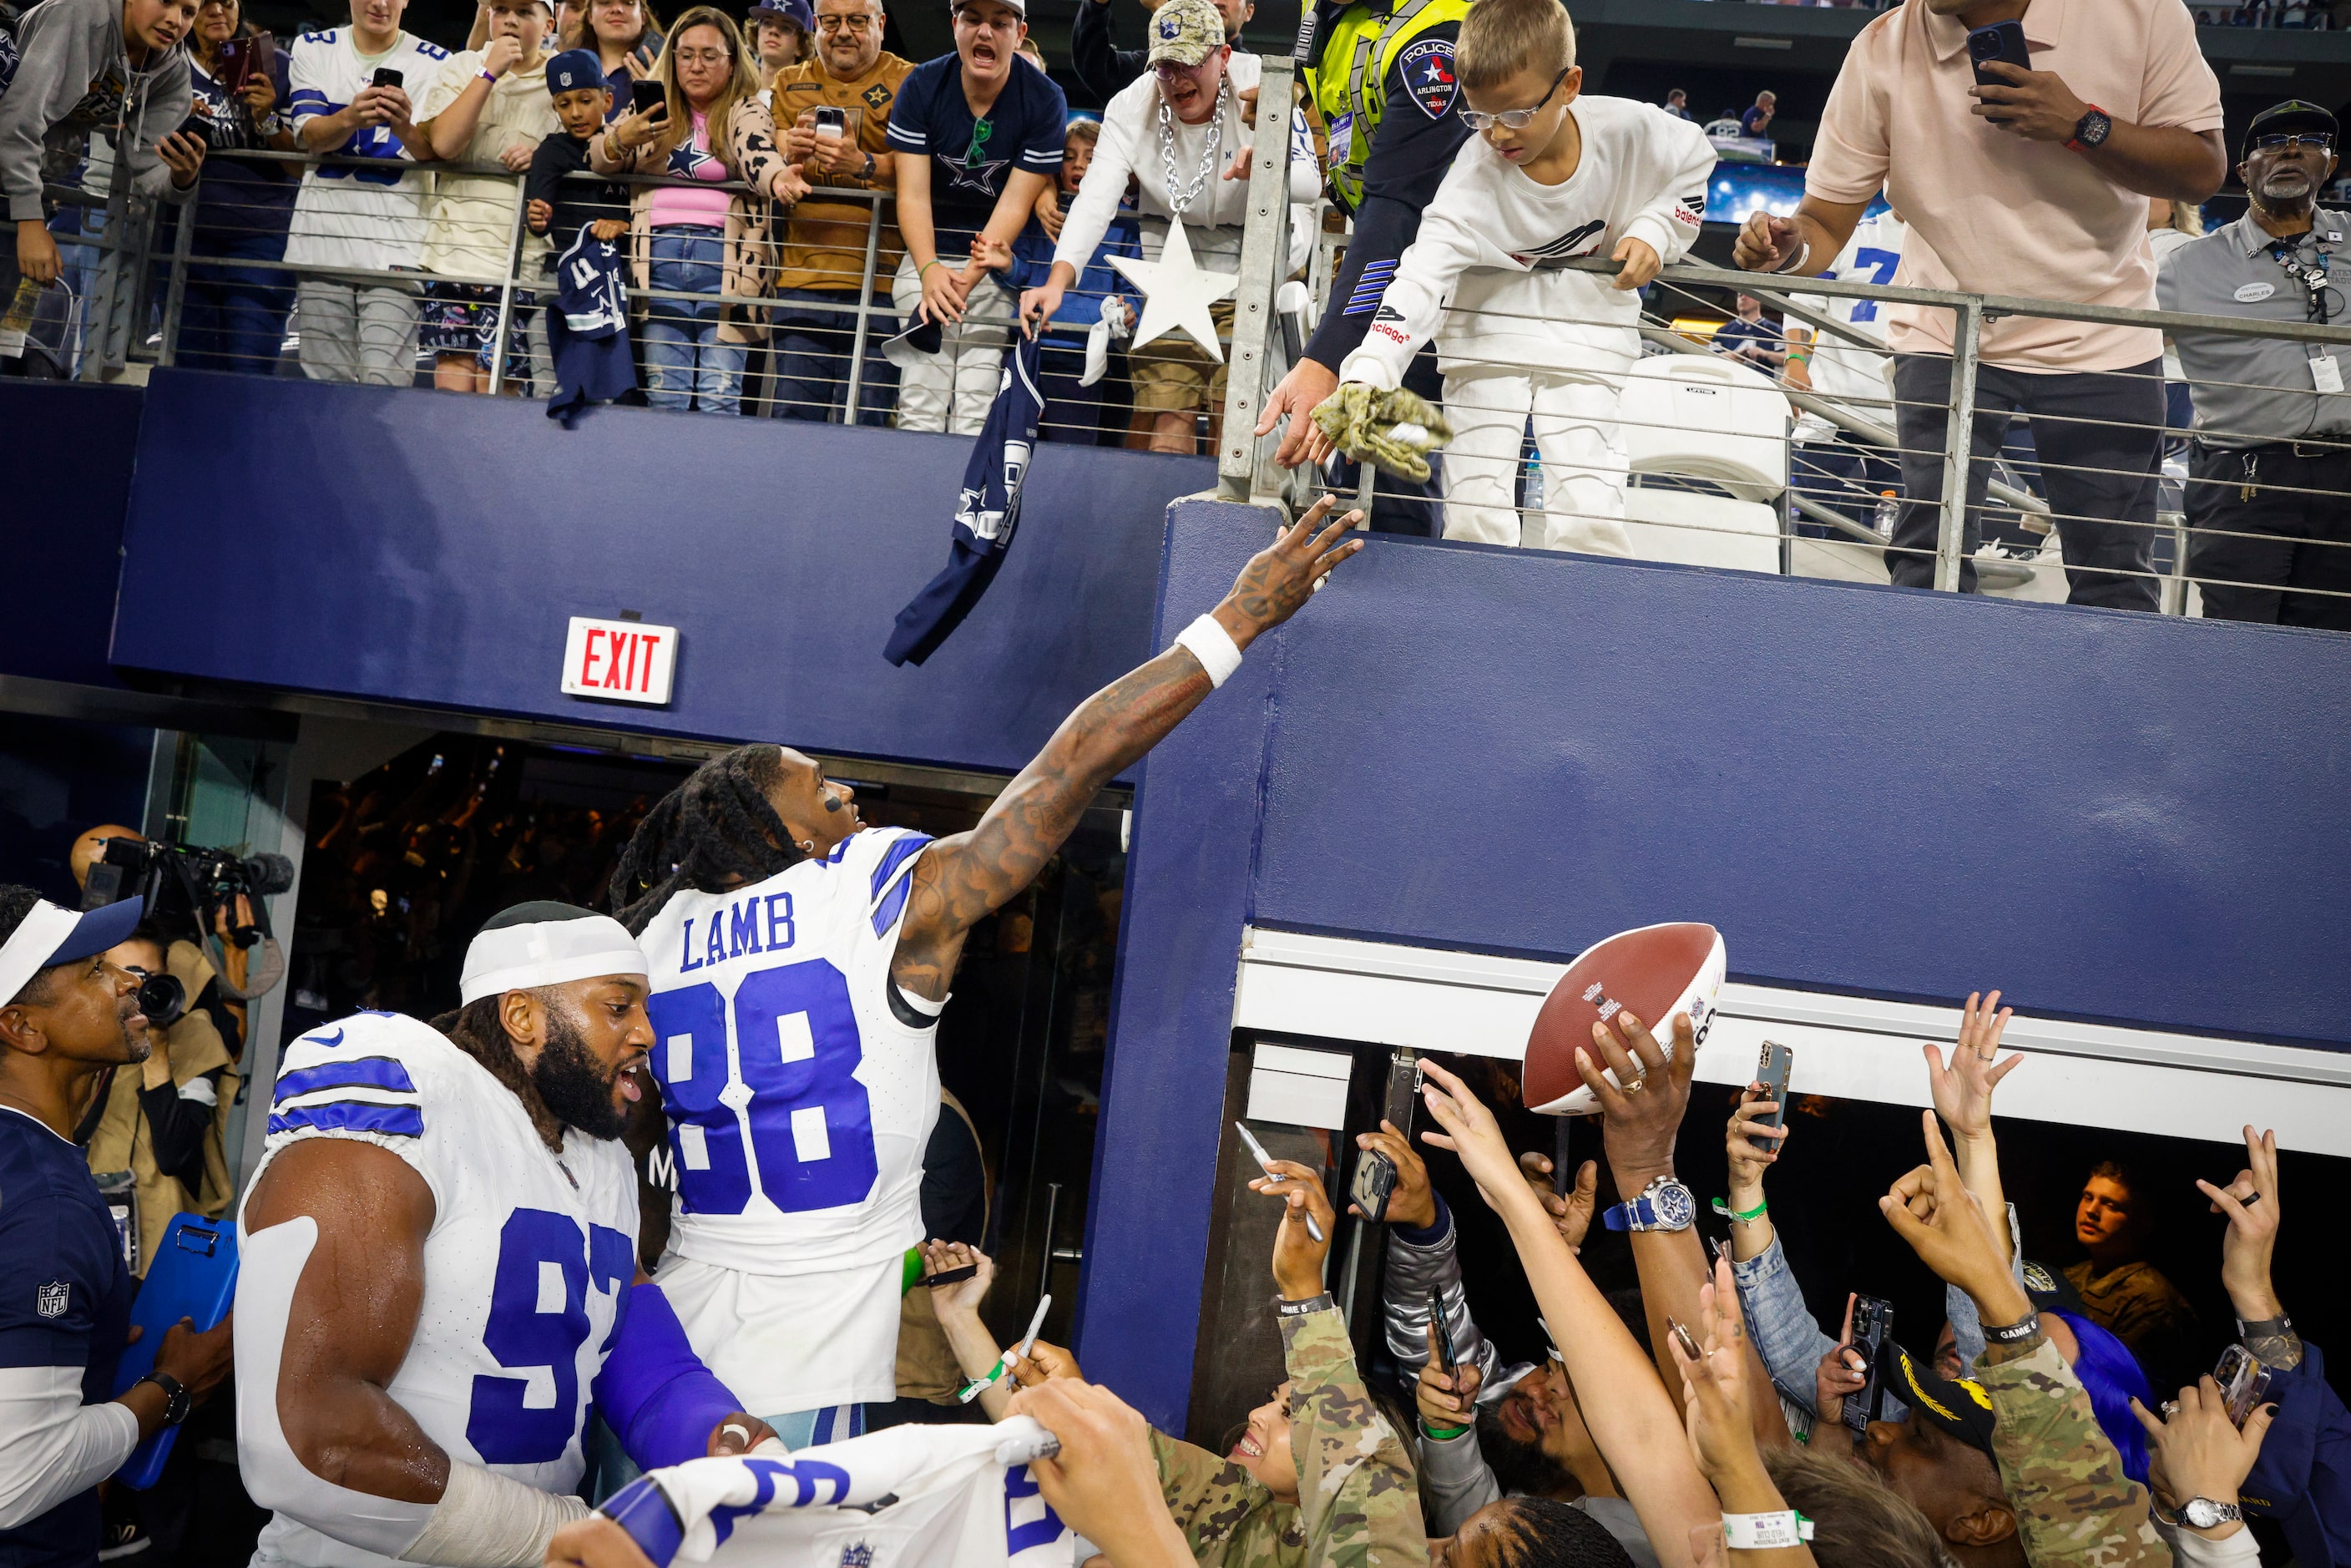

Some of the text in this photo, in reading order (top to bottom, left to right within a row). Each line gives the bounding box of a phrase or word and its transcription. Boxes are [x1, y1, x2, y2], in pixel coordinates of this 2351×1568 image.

[1403, 43, 1454, 63] POLICE
[1417, 84, 1453, 95] ARLINGTON
[570, 257, 601, 290] 11
[1850, 247, 1901, 322] 7
[2238, 290, 2271, 299] CHARLES
[581, 629, 660, 692] EXIT
[680, 892, 794, 974] LAMB
[648, 958, 879, 1215] 88
[41, 1297, 63, 1314] NFL
[1301, 1303, 1307, 1313] 6
[2000, 1320, 2037, 1339] GAME 6
[1756, 1530, 1771, 1538] CLUB
